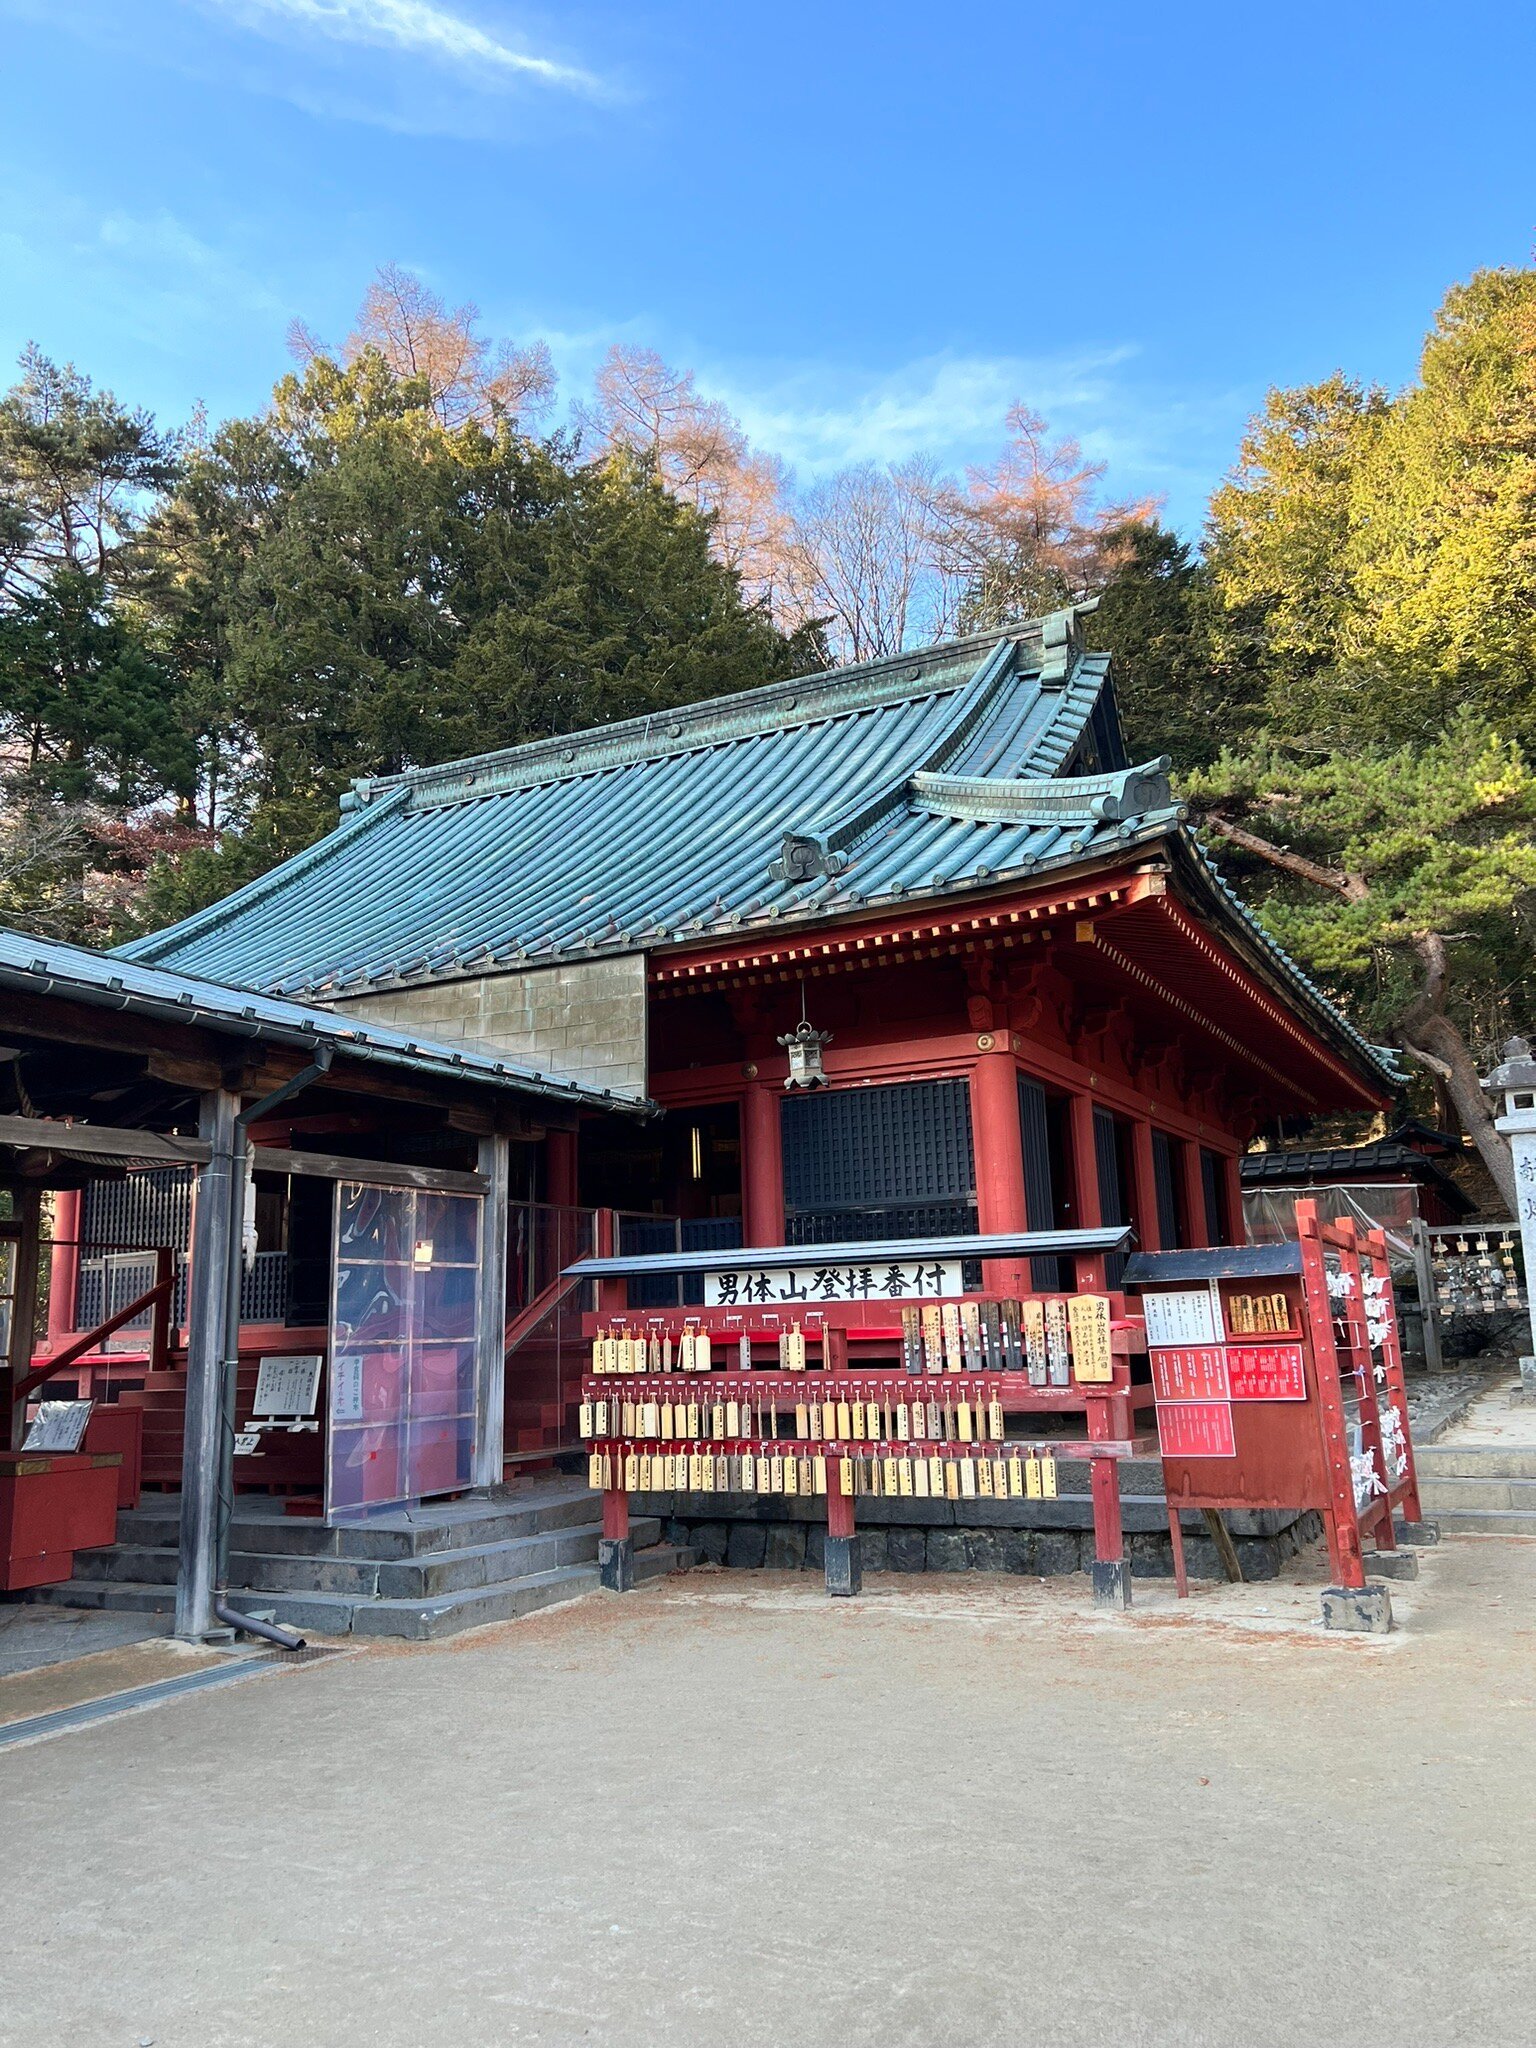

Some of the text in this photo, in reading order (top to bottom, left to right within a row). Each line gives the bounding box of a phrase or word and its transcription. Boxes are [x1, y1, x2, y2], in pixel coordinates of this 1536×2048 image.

[716, 1263, 947, 1305] 男体山登拝番付
